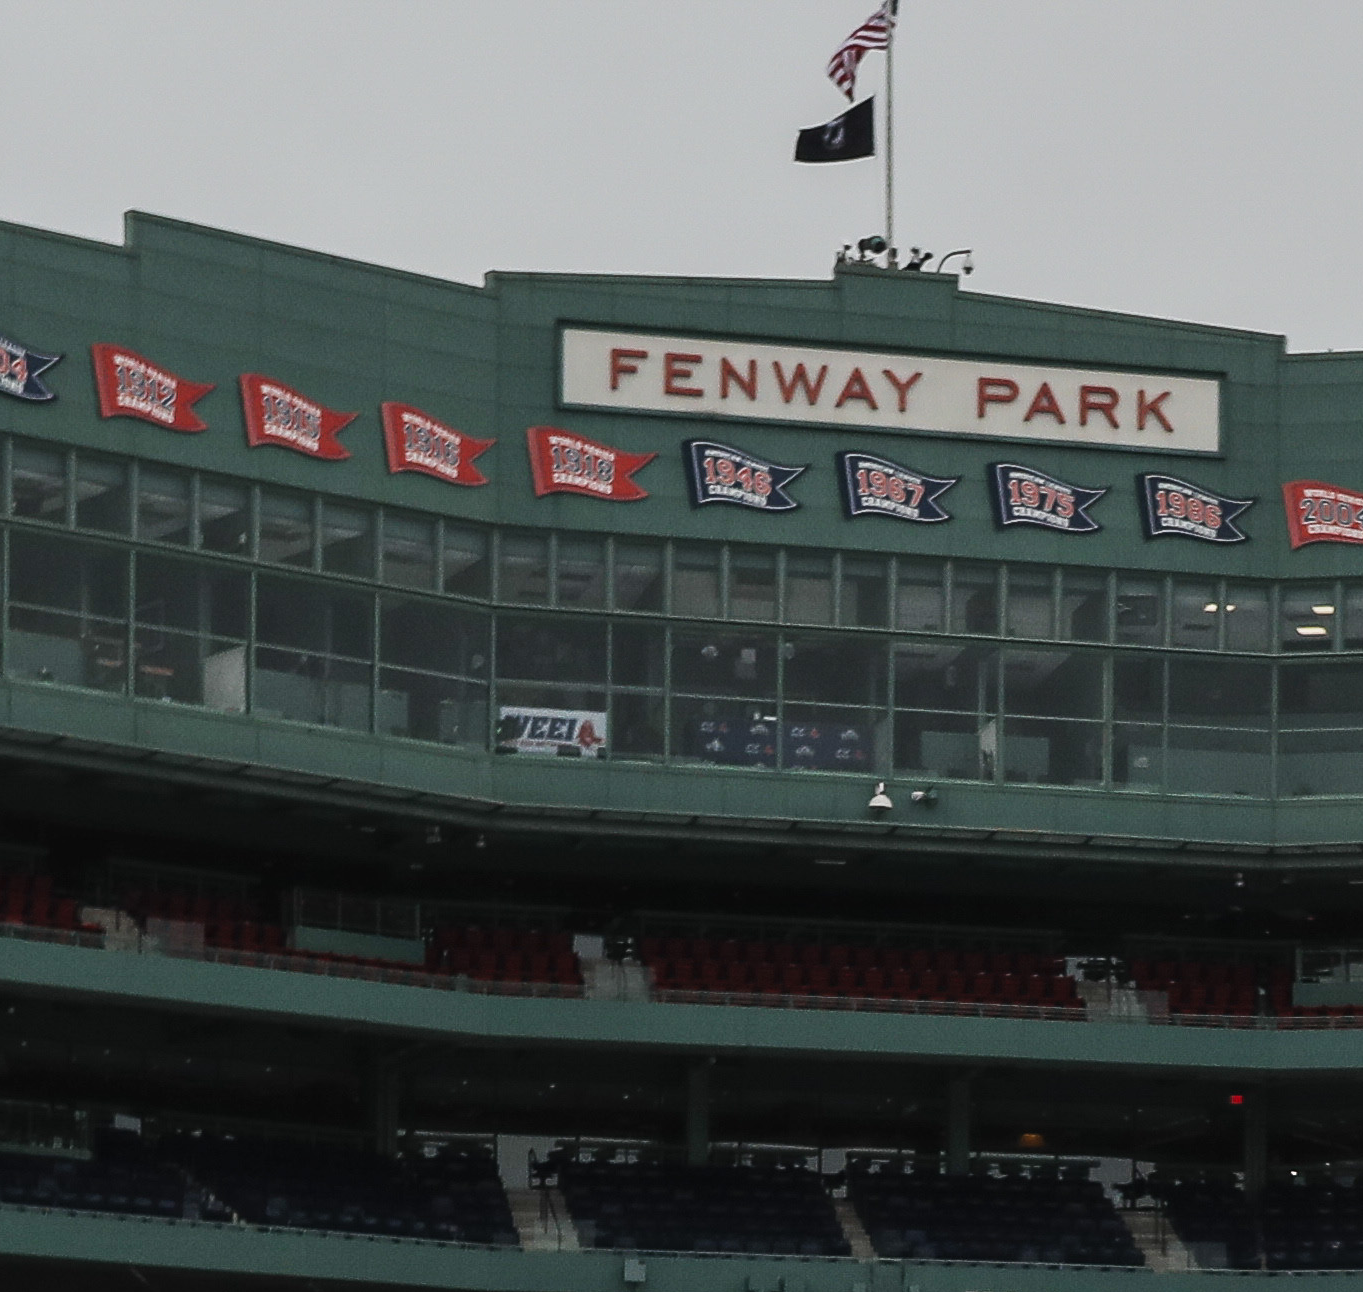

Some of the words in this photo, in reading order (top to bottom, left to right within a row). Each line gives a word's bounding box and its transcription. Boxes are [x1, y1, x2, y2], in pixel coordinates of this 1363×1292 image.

[610, 348, 922, 412] FENWAY
[976, 377, 1173, 433] PARK
[703, 457, 772, 496] 1946
[857, 469, 926, 507] 1967
[1008, 480, 1076, 518] 1975
[1156, 490, 1222, 529] 1986
